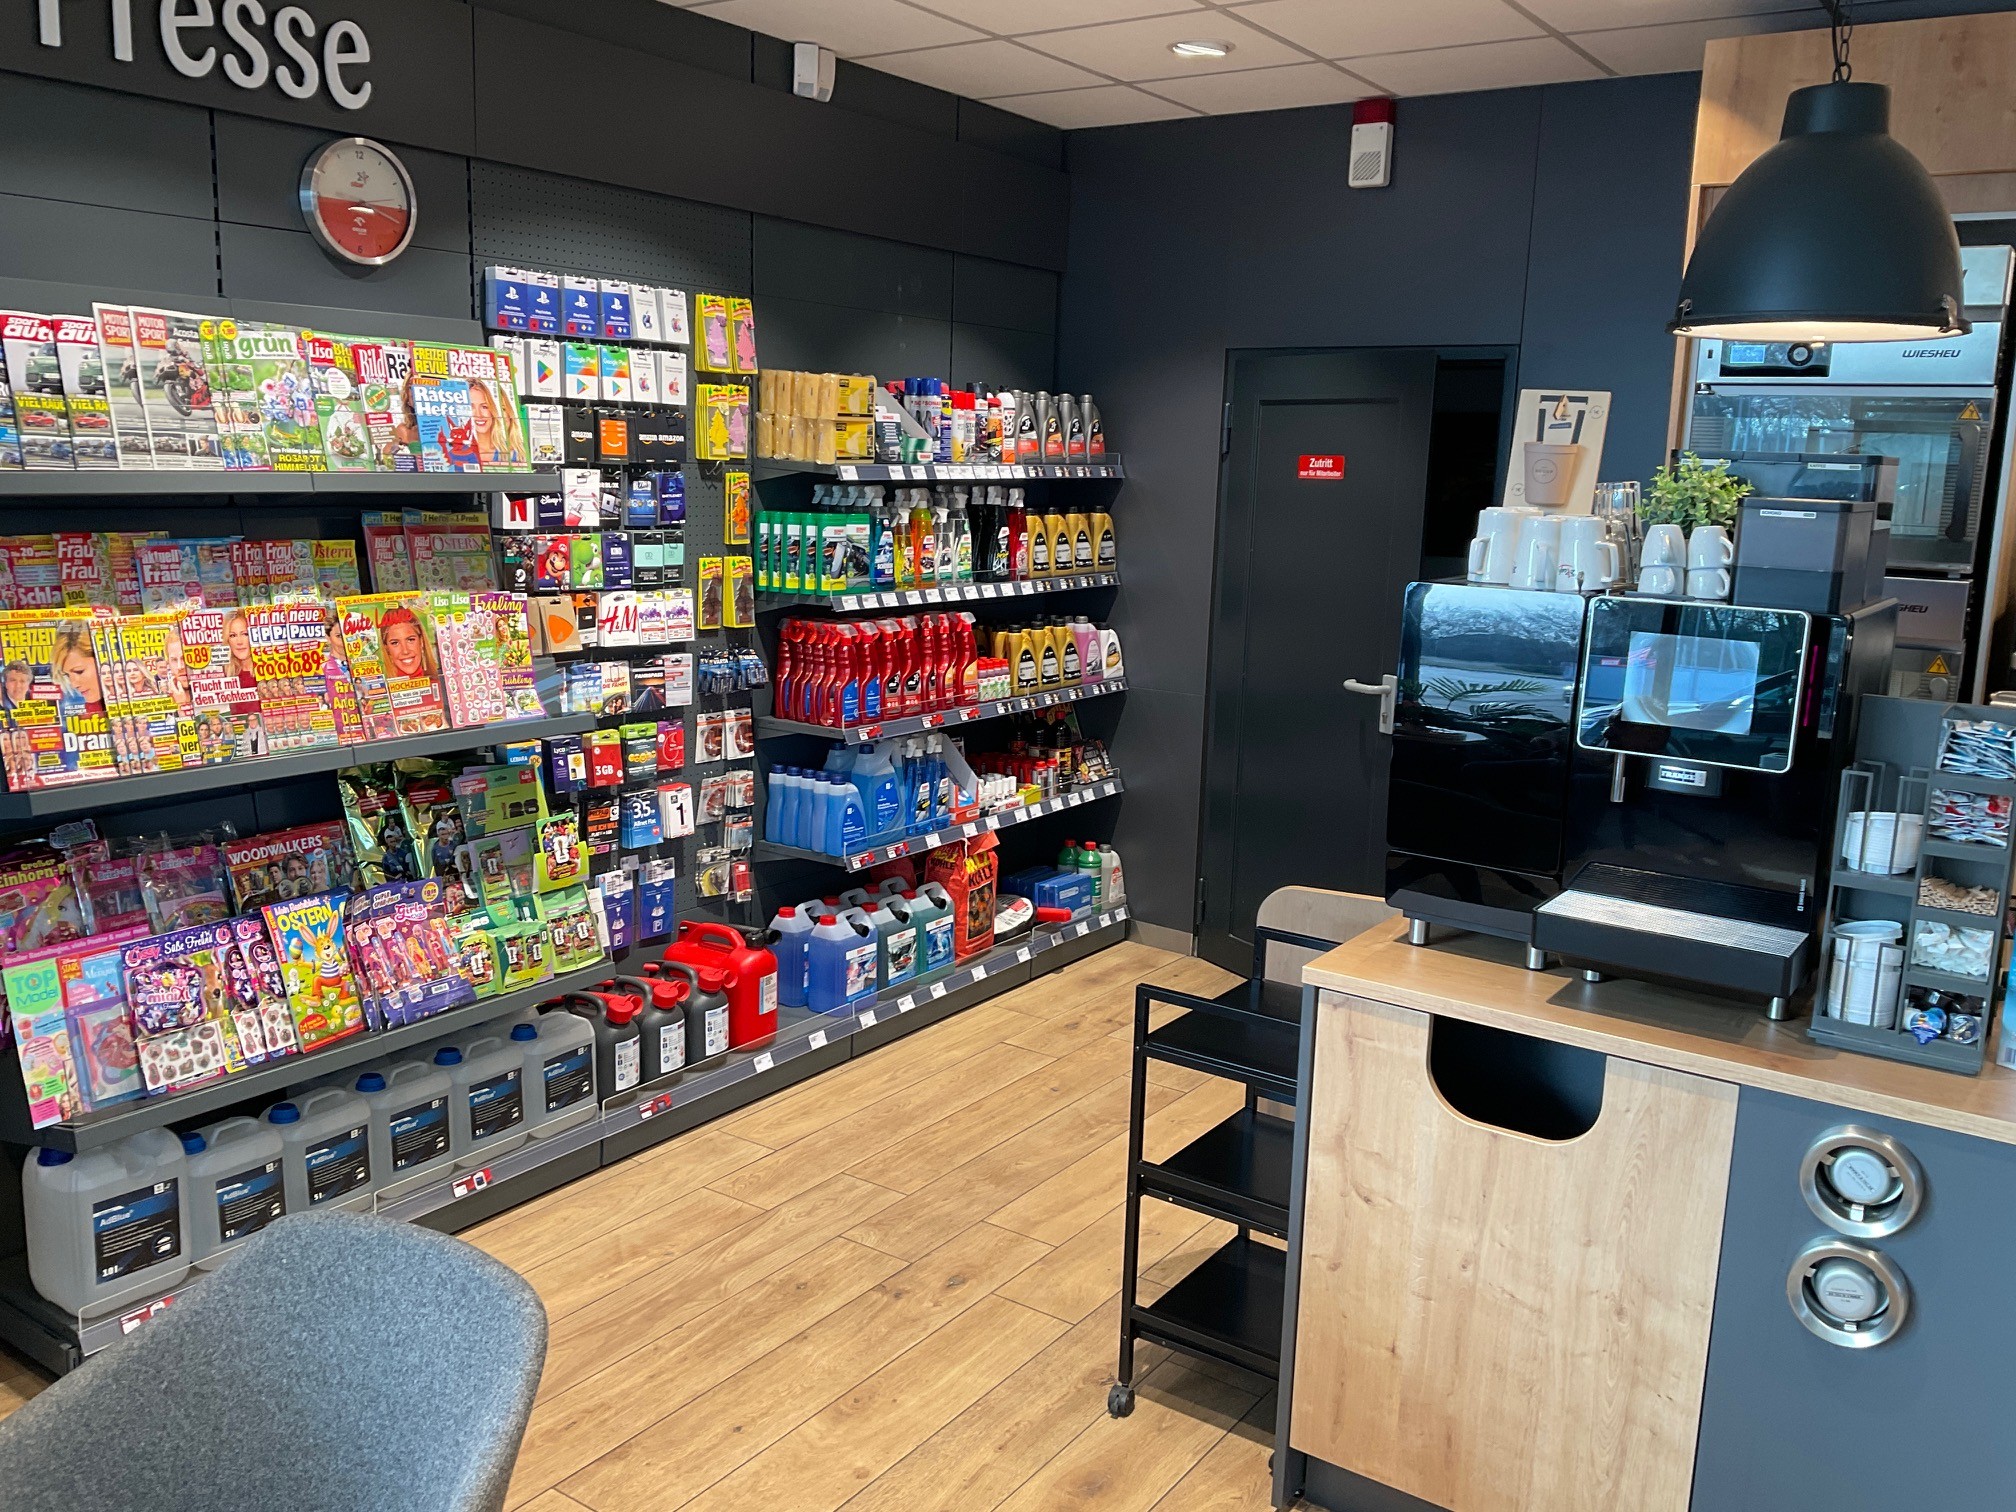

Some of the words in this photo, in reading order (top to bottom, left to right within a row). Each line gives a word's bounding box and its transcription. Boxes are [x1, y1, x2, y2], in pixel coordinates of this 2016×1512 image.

[7, 317, 40, 328] sport
[60, 321, 93, 332] sport
[138, 316, 165, 329] MOTOR
[140, 328, 166, 340] SPORT
[238, 332, 293, 359] grün
[309, 342, 333, 359] Lisa
[1902, 349, 1961, 358] WIESHEU
[358, 348, 386, 378] Bild
[413, 347, 448, 363] FREIZEIT
[450, 350, 494, 367] RÄTSEL
[567, 355, 586, 364] Google
[415, 359, 449, 375] REVUE
[451, 363, 496, 380] KAISER
[16, 396, 41, 408] VIEL
[413, 386, 469, 404] Rätsel
[70, 398, 94, 411] VIEL
[415, 401, 456, 417] Heft
[658, 434, 685, 442] amazon
[1309, 457, 1334, 468] Zutritt
[20, 547, 34, 557] 20
[57, 541, 94, 558] Frau
[142, 549, 180, 564] aktuell
[266, 542, 292, 561] Frau
[62, 561, 98, 580] Frau
[143, 564, 181, 583] Frau
[267, 561, 294, 576] Trend
[66, 590, 85, 600] 100
[433, 596, 449, 607] Lisa
[451, 594, 469, 605] Lisa
[40, 610, 58, 620] süße
[60, 609, 92, 618] Teilchen
[182, 613, 223, 630] REVUE
[289, 609, 319, 621] neue
[600, 605, 638, 635] H&M
[343, 611, 373, 635] Gute
[184, 629, 223, 645] WOCHE
[186, 646, 209, 667] 0,89
[192, 679, 223, 693] Flucht
[224, 677, 239, 690] mit
[390, 678, 429, 692] HOCHZEIT?
[195, 692, 215, 705] den
[215, 689, 257, 703] Töchtern
[228, 834, 323, 865] WOODWALKERS
[21, 858, 56, 871] Großer
[276, 902, 333, 932] OSTERN
[12, 969, 56, 995] TOP
[16, 987, 59, 1007] Model
